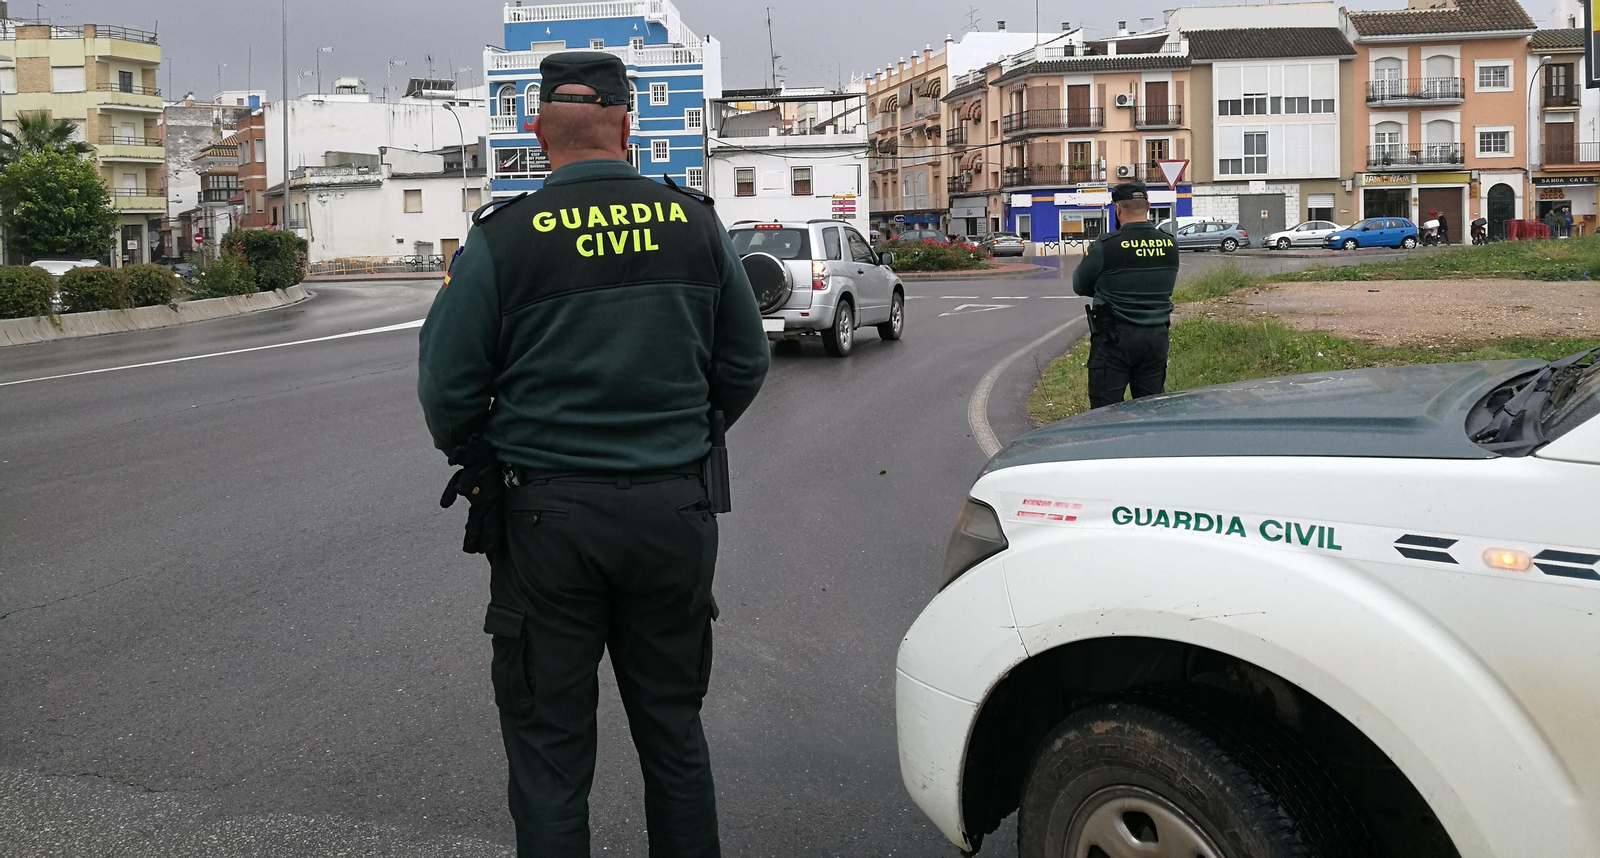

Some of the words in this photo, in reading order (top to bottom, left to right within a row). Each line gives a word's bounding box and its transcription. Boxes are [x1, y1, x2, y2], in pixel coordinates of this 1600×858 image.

[532, 202, 688, 233] GUARDIA
[576, 228, 659, 257] CIVIL
[1120, 238, 1174, 249] GUARDIA
[1135, 247, 1166, 257] CIVIL
[1112, 506, 1247, 538] GUARDIA
[1259, 519, 1342, 551] CIVIL
[1052, 742, 1208, 806] DUELER
